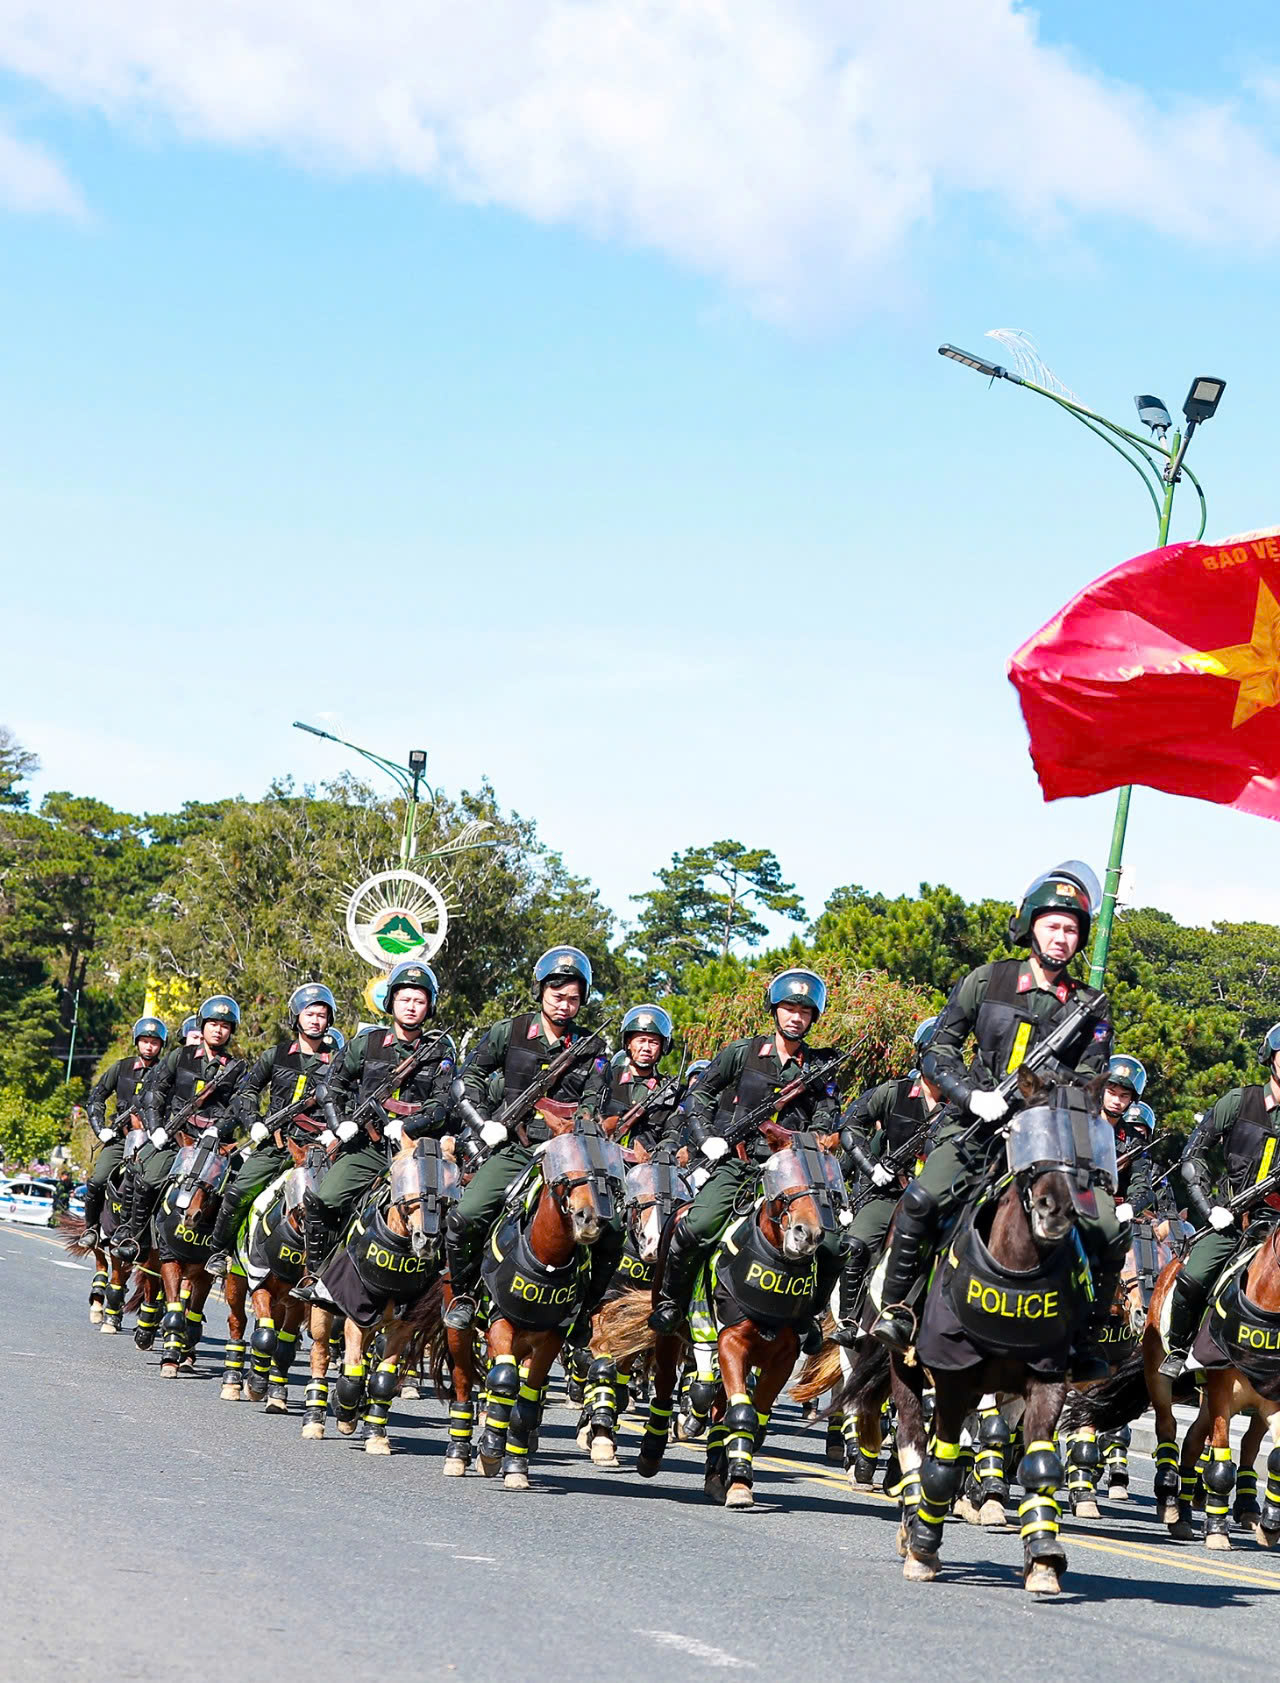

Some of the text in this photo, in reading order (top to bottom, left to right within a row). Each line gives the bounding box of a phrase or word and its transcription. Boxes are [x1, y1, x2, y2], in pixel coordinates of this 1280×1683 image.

[174, 1223, 214, 1247] POLIC
[365, 1241, 426, 1274] POLICE
[510, 1275, 577, 1305] POLICE
[746, 1262, 813, 1296] POLICE
[966, 1278, 1058, 1319] POLICE
